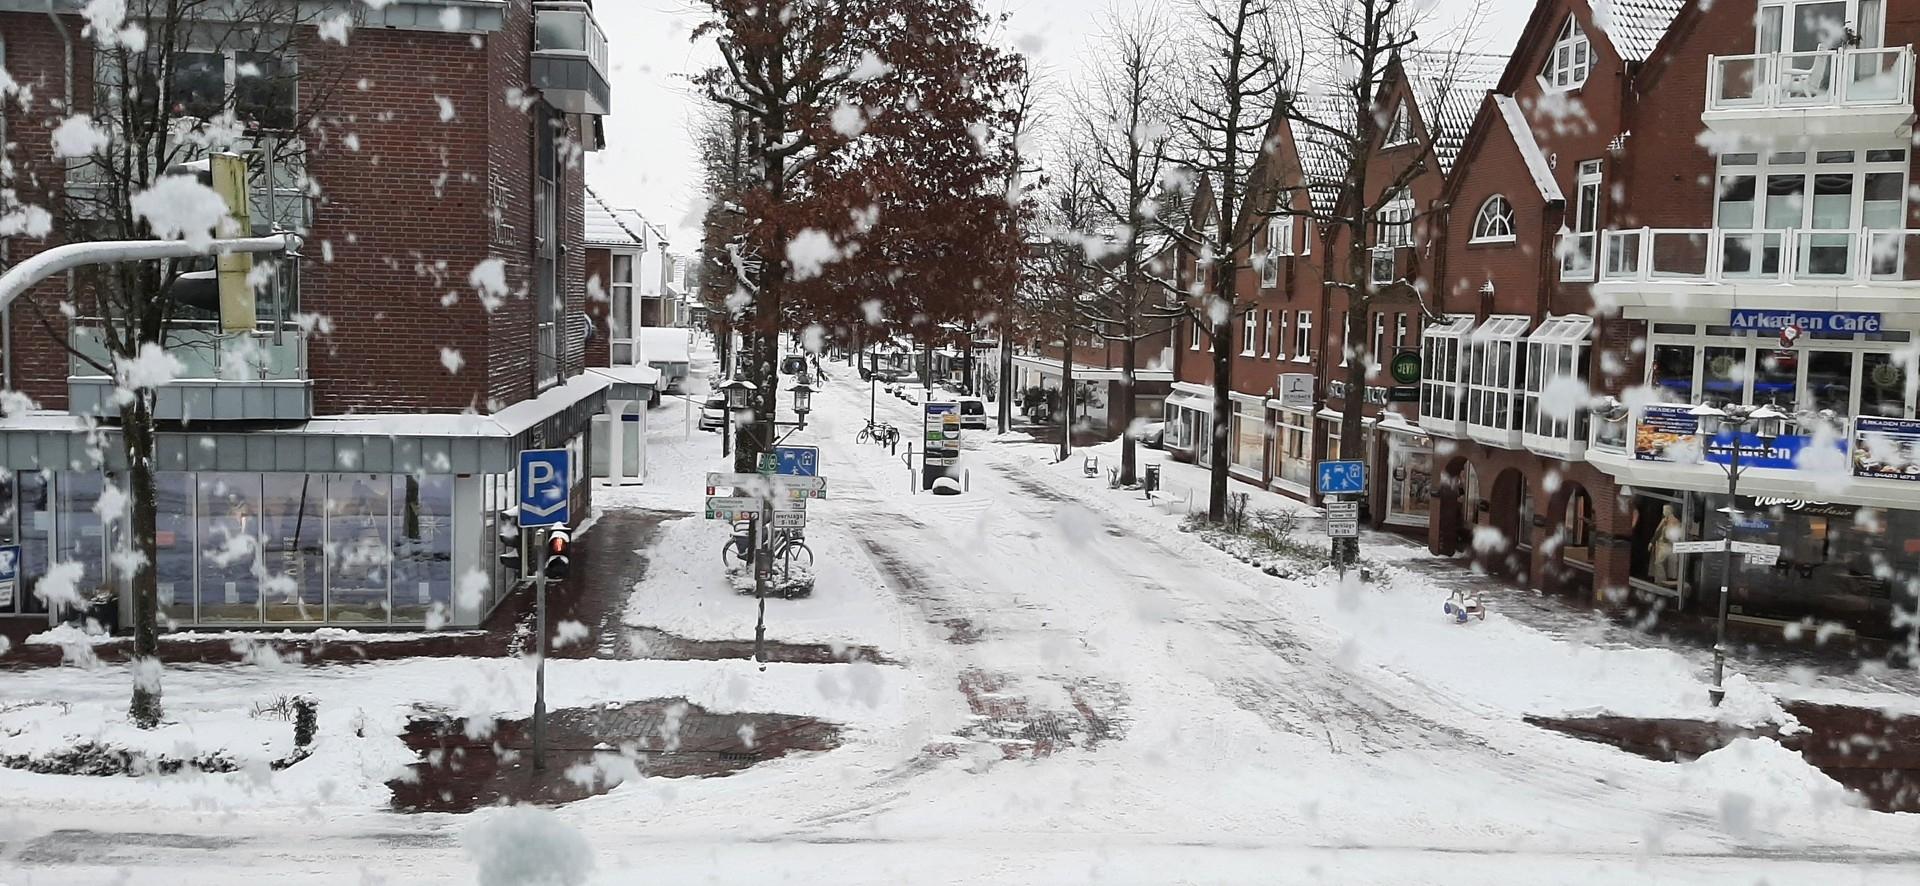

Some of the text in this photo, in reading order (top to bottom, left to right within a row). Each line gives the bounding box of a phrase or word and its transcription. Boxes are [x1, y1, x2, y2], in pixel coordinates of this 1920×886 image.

[1732, 312, 1879, 332] Arkaden Café
[528, 461, 554, 498] P
